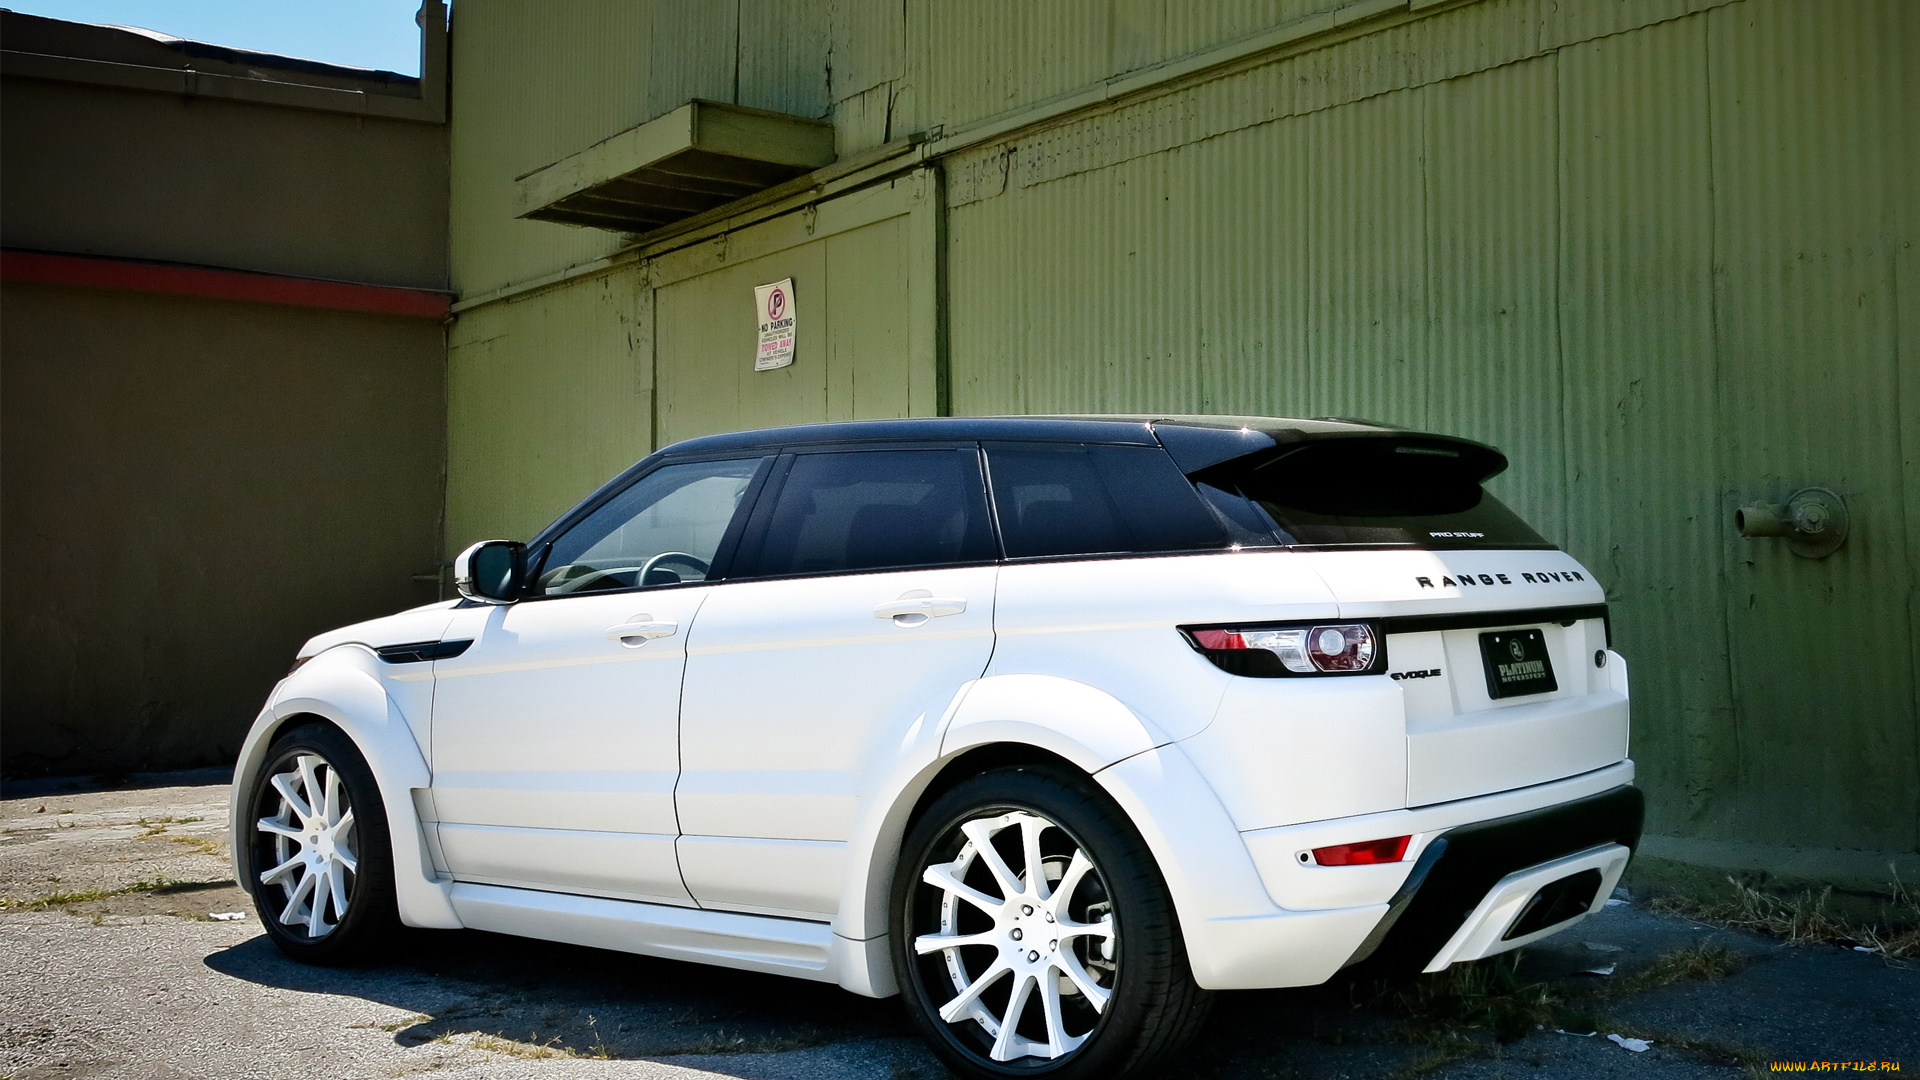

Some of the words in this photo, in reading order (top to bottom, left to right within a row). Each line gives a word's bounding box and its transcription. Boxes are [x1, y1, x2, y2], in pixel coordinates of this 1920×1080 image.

[762, 324, 768, 332] NO
[771, 318, 792, 330] PARKING
[762, 341, 778, 352] TOWED
[780, 338, 793, 348] AWAY
[1415, 573, 1512, 588] RANGE
[1521, 571, 1585, 584] ROVER
[1390, 668, 1441, 680] EVOQUE
[1498, 660, 1545, 677] PLATINUM
[1502, 672, 1546, 683] MOTORSPORT
